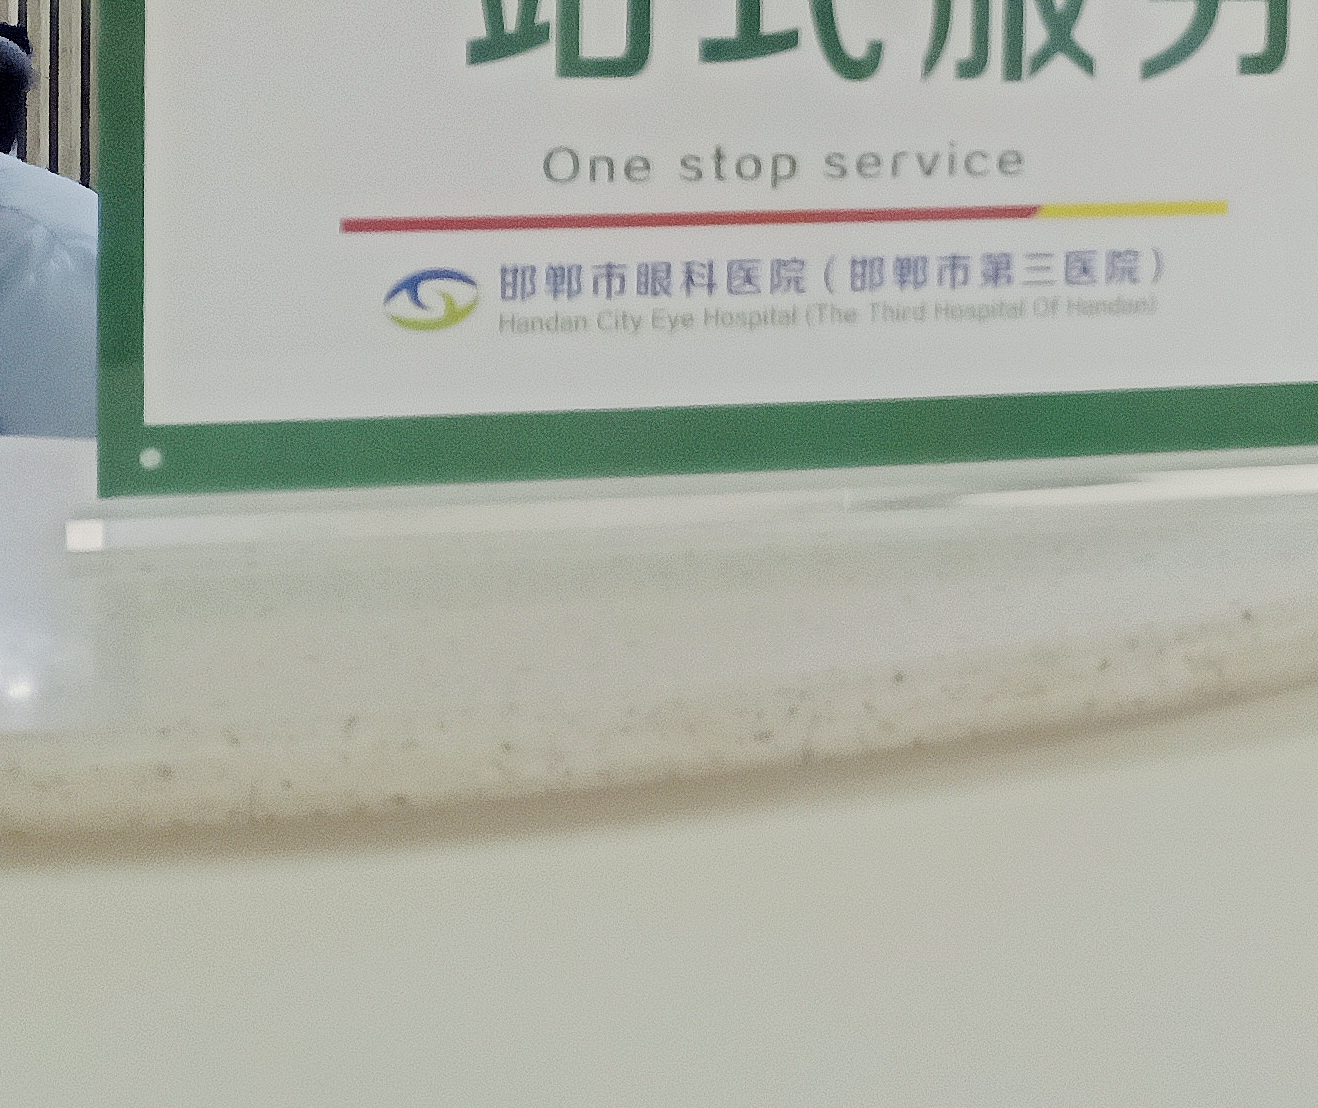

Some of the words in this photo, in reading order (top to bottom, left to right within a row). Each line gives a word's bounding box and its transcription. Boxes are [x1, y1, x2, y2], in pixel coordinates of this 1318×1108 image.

[543, 144, 652, 185] One
[679, 144, 798, 190] stop
[823, 140, 1026, 180] service
[499, 311, 588, 334] Handan
[597, 308, 642, 334] City
[651, 306, 695, 332] Eye
[703, 303, 798, 331] Hospital
[805, 301, 858, 325] (The
[870, 300, 928, 325] Third
[935, 299, 1027, 324] Hospital
[1032, 295, 1060, 319] Of
